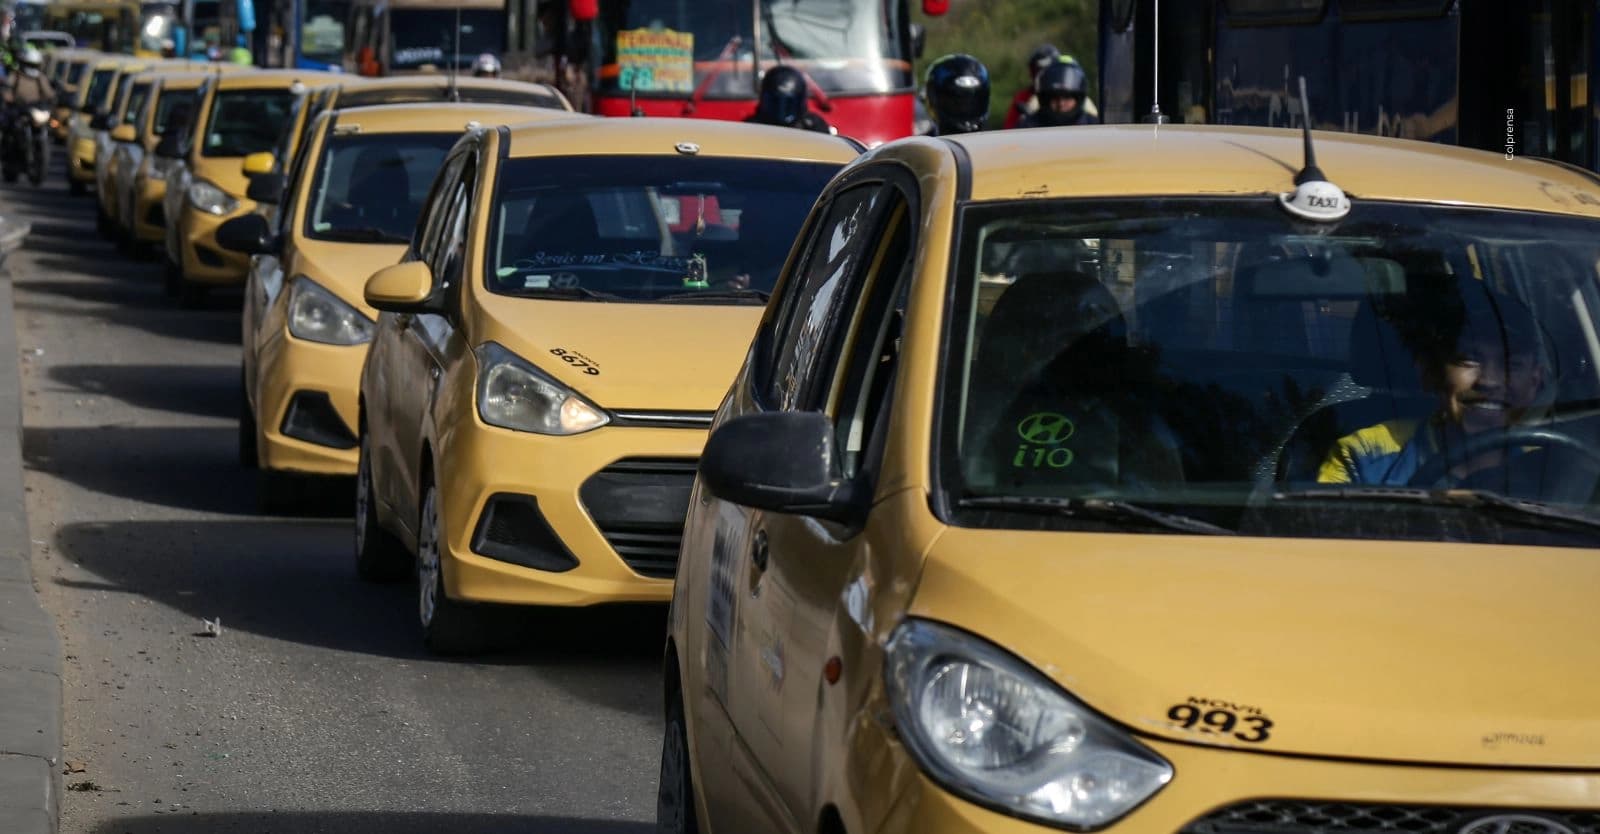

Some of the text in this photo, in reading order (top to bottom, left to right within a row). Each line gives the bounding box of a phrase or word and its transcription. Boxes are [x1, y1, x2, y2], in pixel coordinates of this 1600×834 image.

[1307, 194, 1339, 208] TAXI
[549, 347, 600, 375] 8679
[1013, 444, 1073, 468] i10
[1167, 704, 1274, 742] 993
